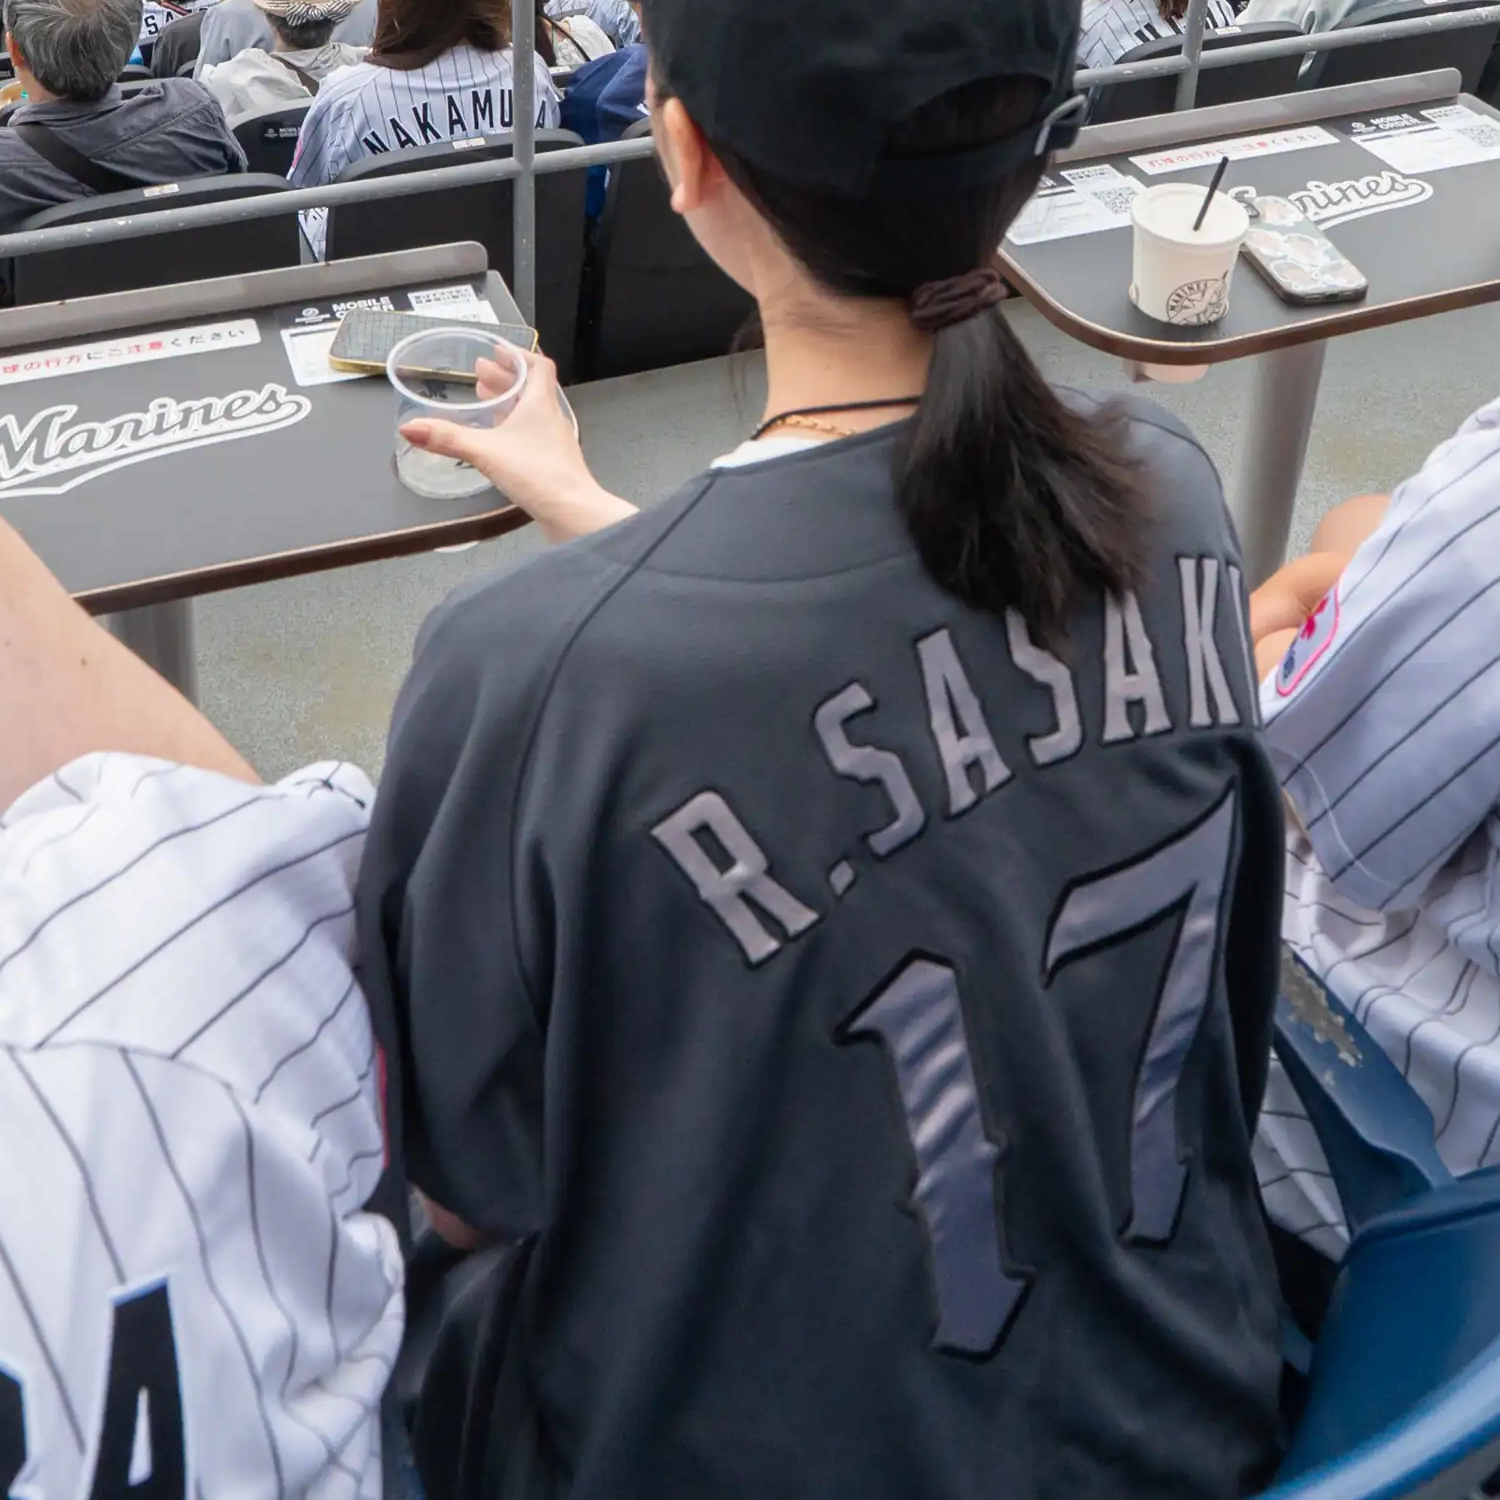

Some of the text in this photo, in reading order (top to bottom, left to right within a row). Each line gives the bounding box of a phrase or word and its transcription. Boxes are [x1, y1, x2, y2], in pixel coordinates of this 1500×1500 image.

[364, 92, 547, 154] NAKAMUA
[332, 296, 392, 313] MOBILE
[833, 775, 1238, 1363] 17
